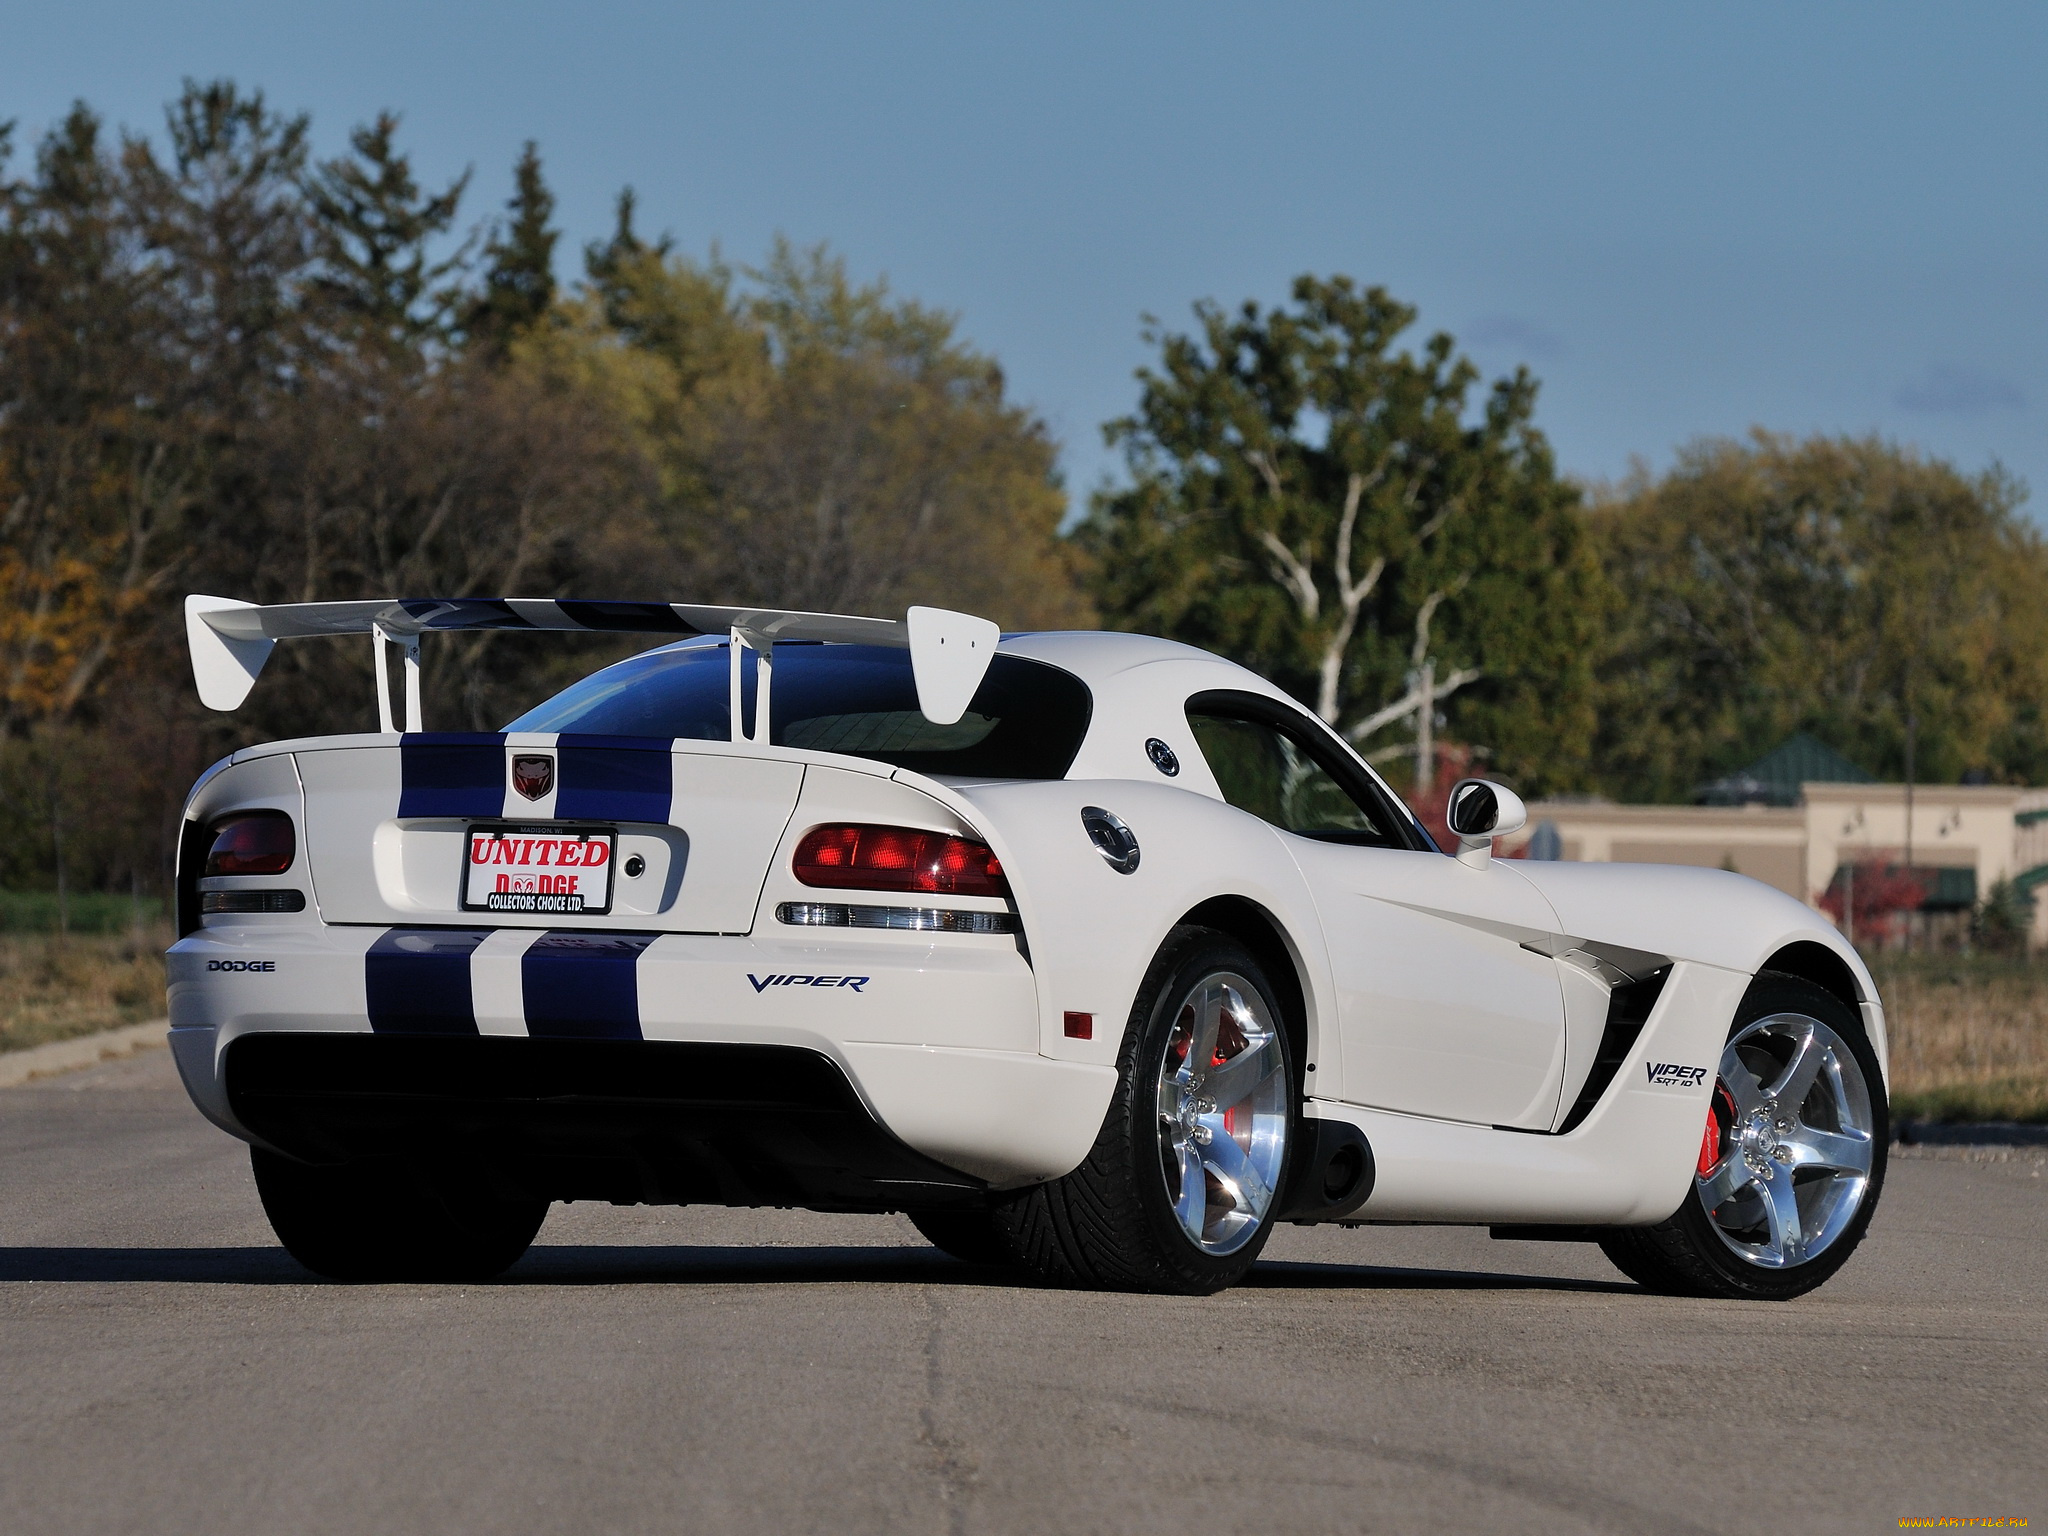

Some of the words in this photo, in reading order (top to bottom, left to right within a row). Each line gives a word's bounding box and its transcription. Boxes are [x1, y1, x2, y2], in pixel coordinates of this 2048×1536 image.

[471, 838, 609, 866] UNITED
[489, 894, 536, 910] COLLECTORS
[537, 896, 566, 911] CHOICE
[567, 896, 583, 912] LTD.
[206, 960, 276, 973] DODGE
[746, 973, 870, 993] VIPER
[1646, 1061, 1708, 1086] VIPER
[1653, 1077, 1679, 1086] SRT
